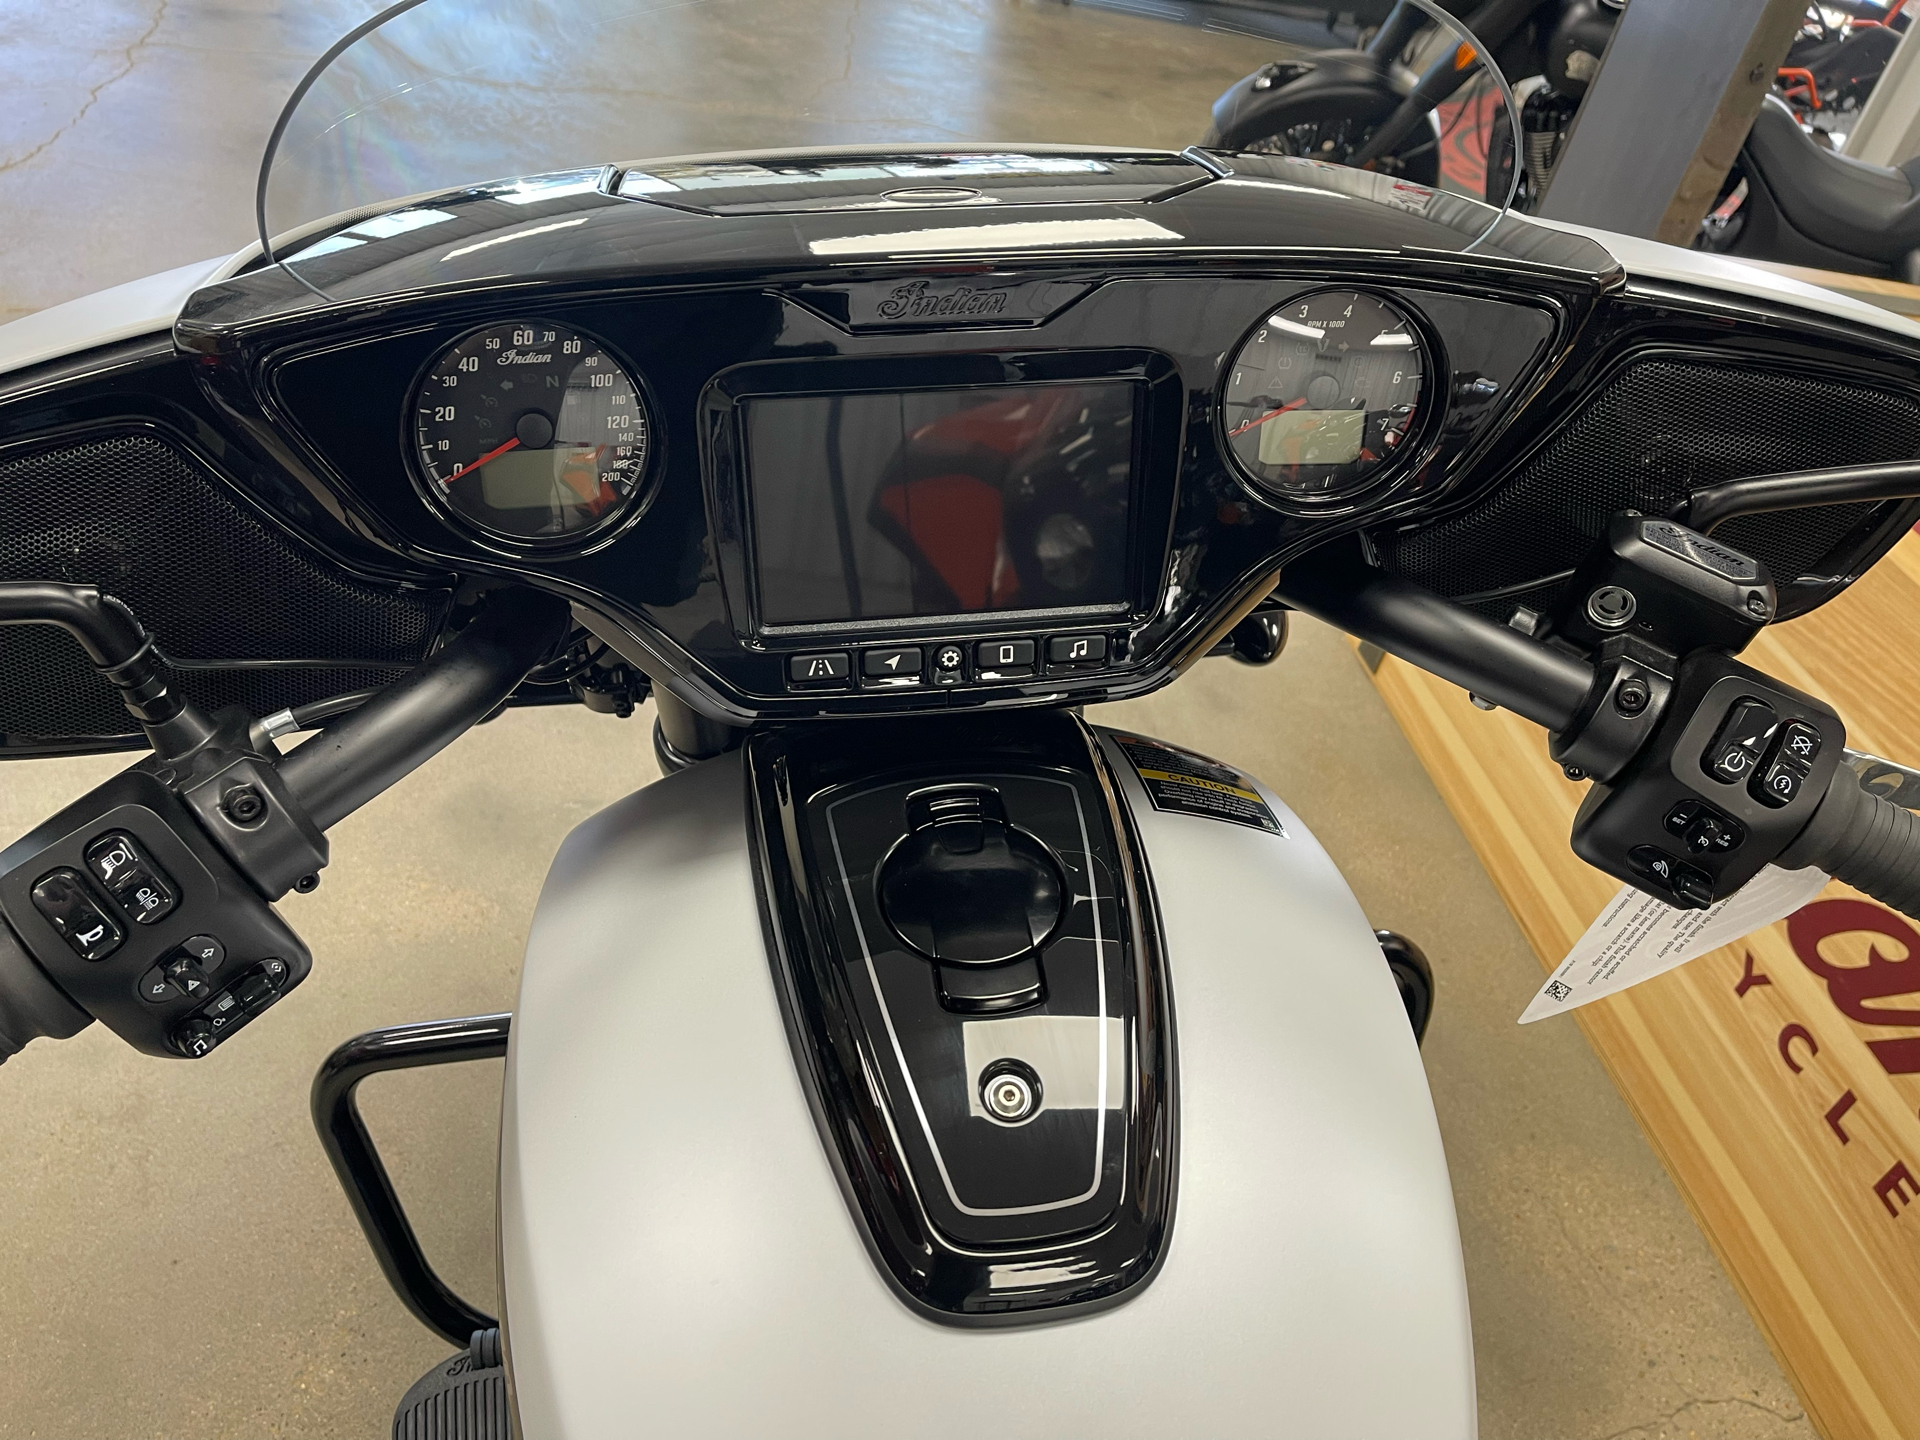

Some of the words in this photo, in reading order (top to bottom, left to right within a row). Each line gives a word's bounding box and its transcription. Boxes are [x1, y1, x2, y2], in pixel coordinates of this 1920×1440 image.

[877, 280, 1008, 320] Indian
[1299, 304, 1308, 318] 3
[1343, 304, 1353, 318] 4
[1307, 320, 1322, 328] RPM
[1329, 320, 1346, 328] 1000
[513, 330, 534, 346] 60
[543, 331, 556, 342] 70
[1258, 330, 1267, 343] 2
[485, 338, 500, 349] 50
[563, 340, 581, 354] 80
[458, 356, 479, 372] 40
[496, 349, 552, 366] Indian
[585, 356, 598, 367] 90
[442, 375, 457, 387] 30
[546, 375, 560, 388] N
[590, 374, 613, 387] 100
[1235, 372, 1242, 385] 1
[1392, 371, 1402, 384] 6
[611, 395, 626, 405] 110
[435, 406, 455, 421] 20
[606, 416, 630, 429] 120
[1380, 418, 1389, 431] 7
[618, 432, 634, 442] 140
[437, 440, 450, 451] 10
[616, 446, 633, 457] 160
[602, 472, 621, 482] 200
[1659, 526, 1745, 567] Indian
[1168, 774, 1237, 795] CAUTION
[1600, 896, 1630, 930] instructions.
[1629, 911, 1642, 925] like
[1691, 910, 1703, 923] and
[1709, 904, 1723, 919] with
[1638, 915, 1650, 928] less
[1645, 906, 1669, 933] becomes
[1701, 915, 1711, 926] the
[1610, 925, 1629, 947] scratch
[1624, 929, 1648, 956] scratched
[1672, 929, 1685, 943] The
[1613, 942, 1626, 956] This
[1655, 938, 1675, 960] quality
[1673, 942, 1685, 954] will
[1600, 953, 1616, 970] finish
[1618, 954, 1626, 962] or
[1586, 966, 1603, 986] cannot
